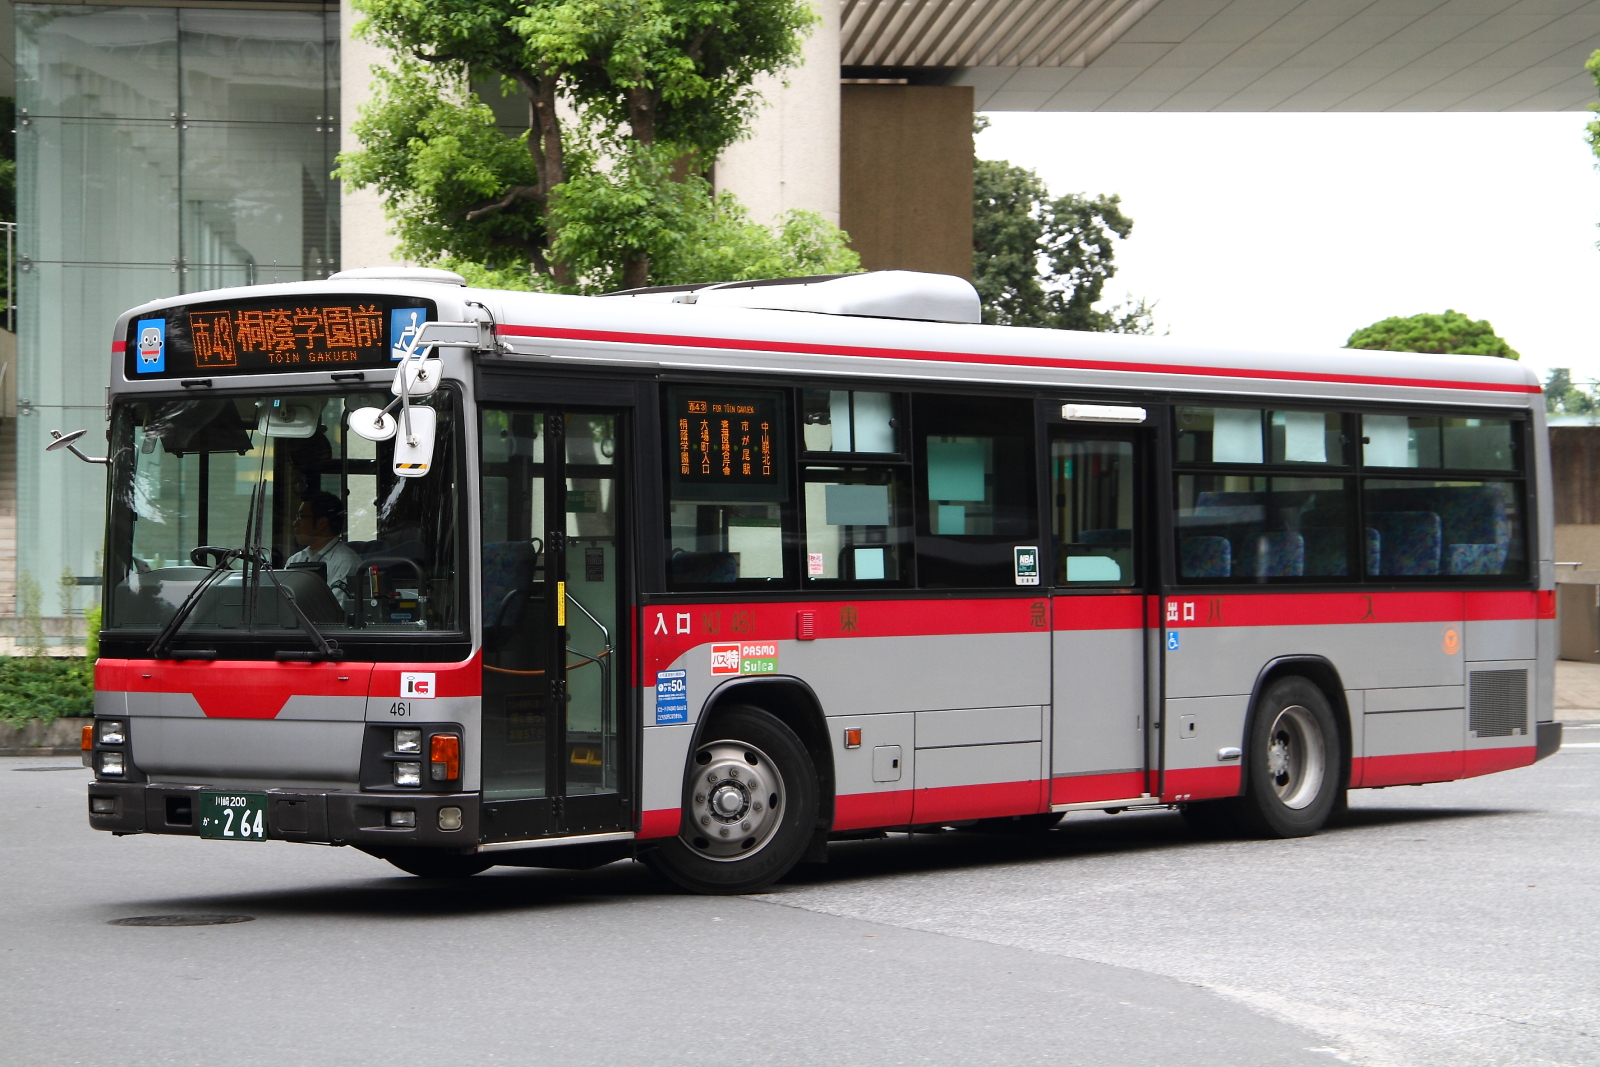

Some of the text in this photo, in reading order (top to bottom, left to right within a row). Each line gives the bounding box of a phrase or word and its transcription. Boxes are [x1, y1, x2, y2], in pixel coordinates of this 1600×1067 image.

[234, 304, 382, 352] 桐蔭学園前
[308, 351, 358, 363] GAKUEN
[700, 419, 710, 475] 大場町入口
[741, 421, 751, 475] 市が尾駅
[761, 421, 770, 475] 中山駅北口
[1019, 554, 1034, 565] NBA
[1166, 602, 1195, 621] 出口
[654, 612, 691, 635] 入口
[742, 645, 775, 656] PASMO
[744, 661, 774, 672] Suica
[390, 702, 411, 717] 461
